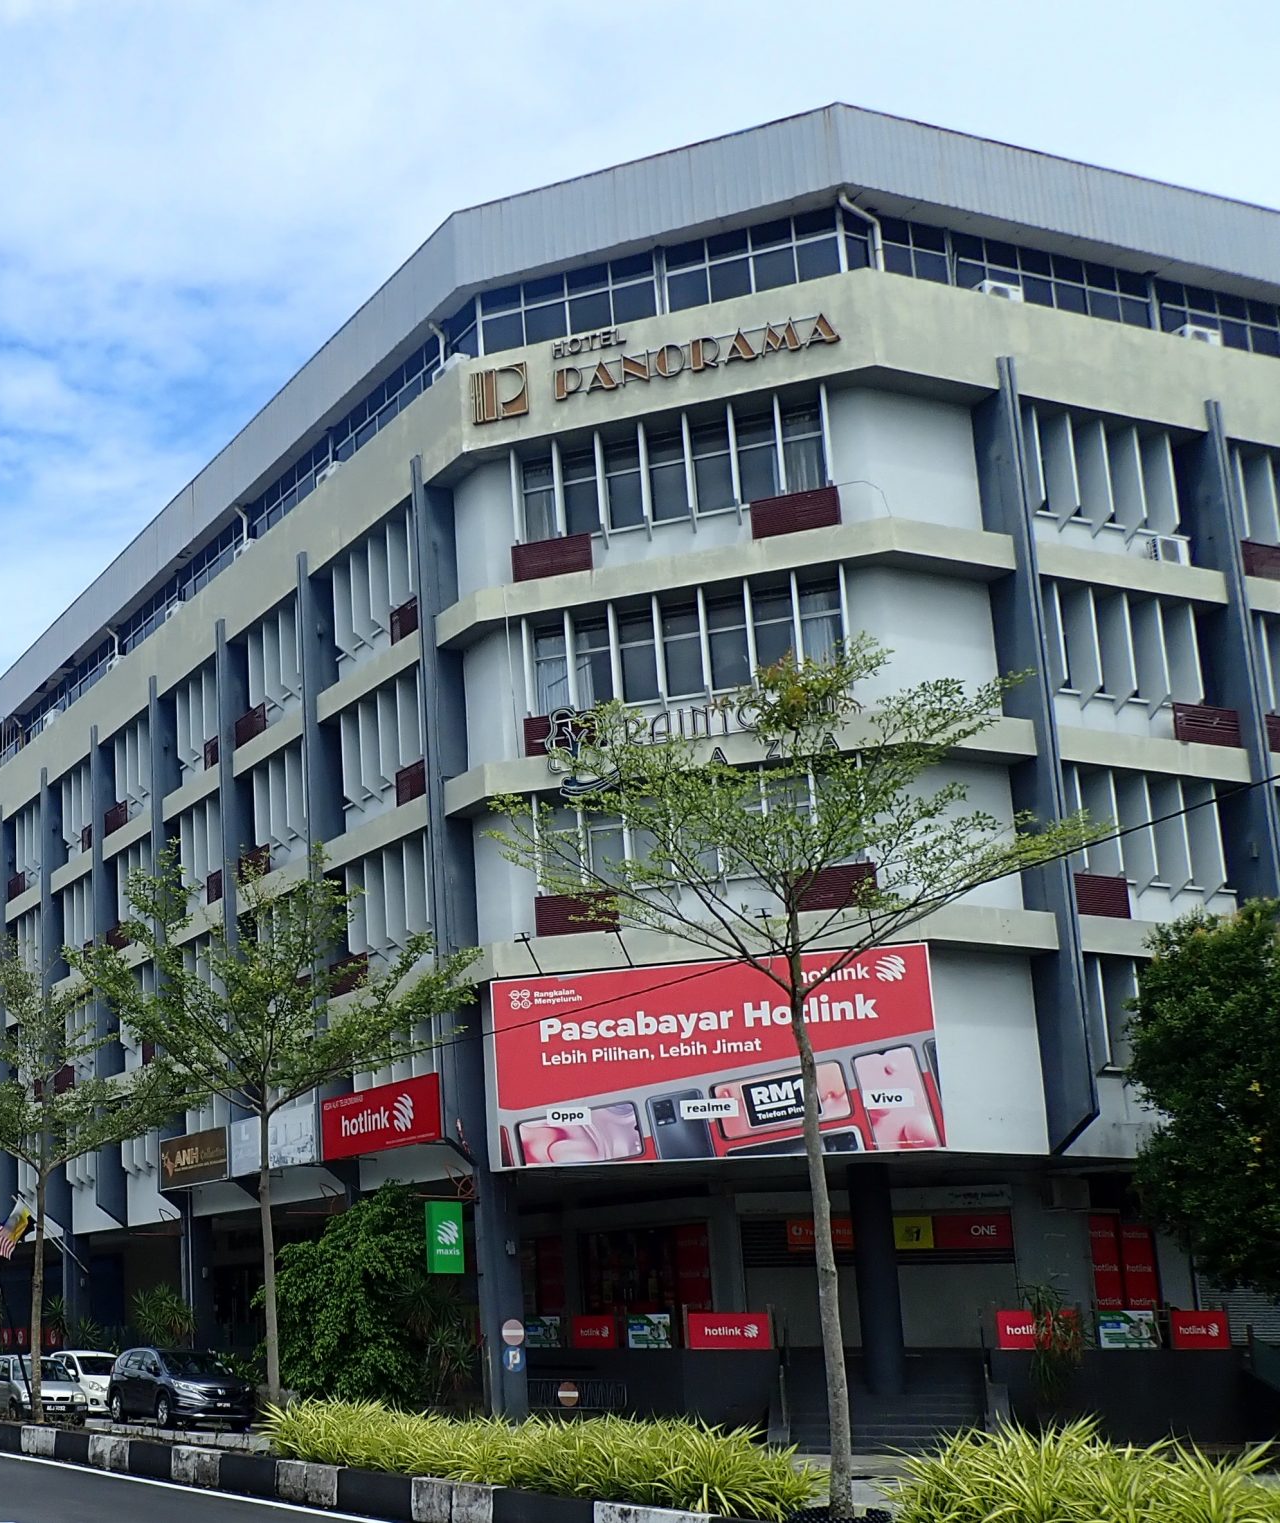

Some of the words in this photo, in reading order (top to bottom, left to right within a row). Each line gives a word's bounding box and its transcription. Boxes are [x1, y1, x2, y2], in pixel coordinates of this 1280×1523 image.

[552, 328, 627, 359] HOTEL
[553, 312, 842, 401] PANORAMA
[534, 988, 576, 998] Rangkaian
[534, 994, 583, 1005] Menyeluruh
[539, 1009, 734, 1043] Pascabayar
[542, 1050, 588, 1067] Lebih
[592, 1046, 655, 1063] Pilihan,
[659, 1042, 708, 1059] Lebih
[712, 1038, 762, 1055] Jimat
[871, 1093, 903, 1104] Vivo
[687, 1102, 732, 1113] realme
[551, 1110, 585, 1122] Oppo
[757, 1107, 787, 1121] Telefon
[788, 1106, 806, 1116] Pint
[341, 1106, 390, 1137] hotlink
[174, 1147, 199, 1167] ANH
[970, 1225, 997, 1236] ONE
[435, 1245, 461, 1256] maxis
[1126, 1264, 1153, 1272] hotlink
[580, 1327, 600, 1337] hotlink
[704, 1325, 741, 1337] hotlink
[1006, 1325, 1036, 1335] hotli
[1179, 1324, 1206, 1335] hotlink
